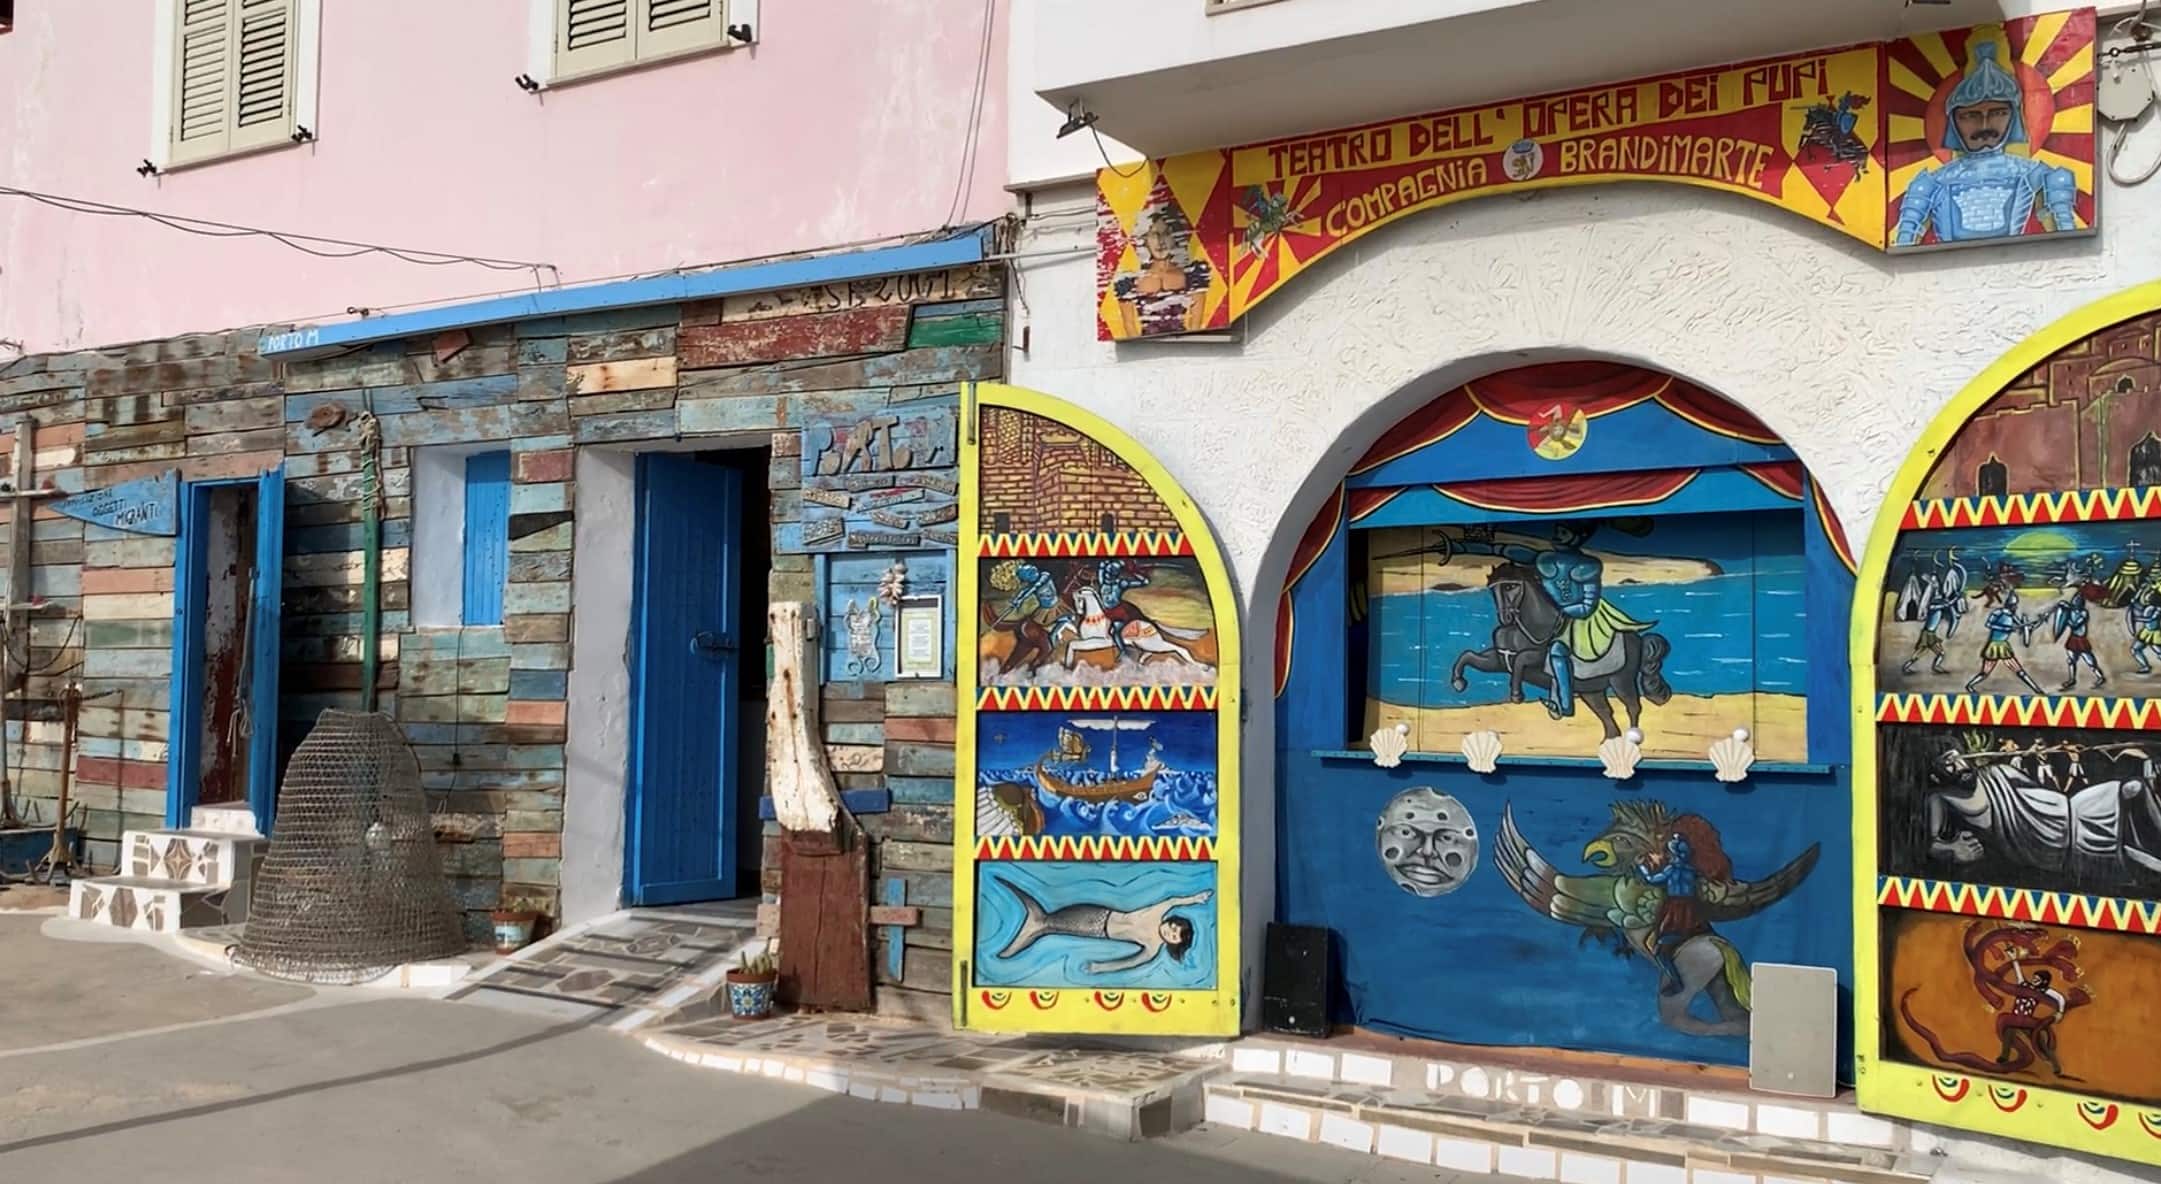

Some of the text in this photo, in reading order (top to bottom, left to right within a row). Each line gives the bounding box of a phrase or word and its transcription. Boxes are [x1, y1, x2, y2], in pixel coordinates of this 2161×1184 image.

[1268, 127, 1393, 179] TEATRO
[1409, 108, 1505, 158] DELL'
[1522, 86, 1638, 139] OPERA
[267, 328, 320, 352] PORTO M
[1426, 1063, 1656, 1117] PORTO M
